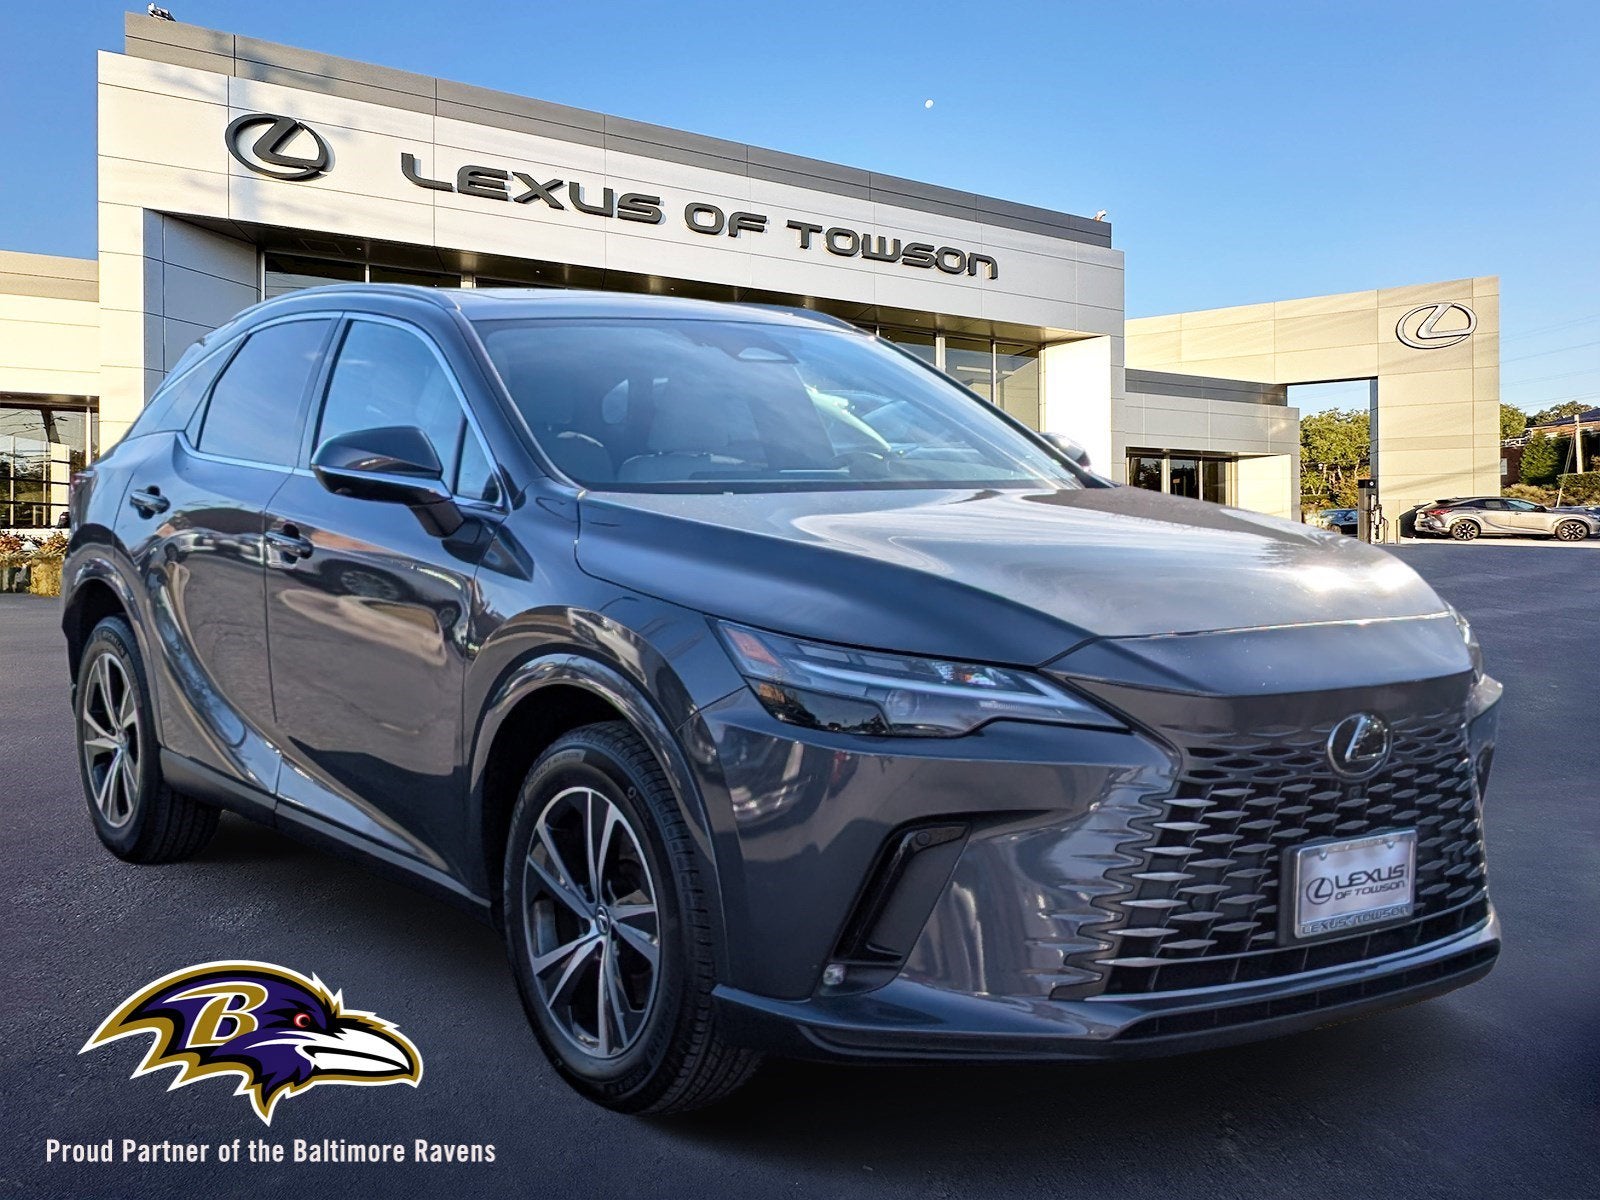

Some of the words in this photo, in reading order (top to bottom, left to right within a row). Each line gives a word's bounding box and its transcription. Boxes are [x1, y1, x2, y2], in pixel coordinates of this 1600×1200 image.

[401, 152, 663, 225] LEXUS
[684, 202, 768, 238] OF
[786, 219, 999, 280] TOWSON
[1335, 864, 1405, 889] LEXUS
[1335, 889, 1353, 901] OF
[1354, 879, 1406, 897] TOWSON
[1302, 919, 1347, 935] LEXUS
